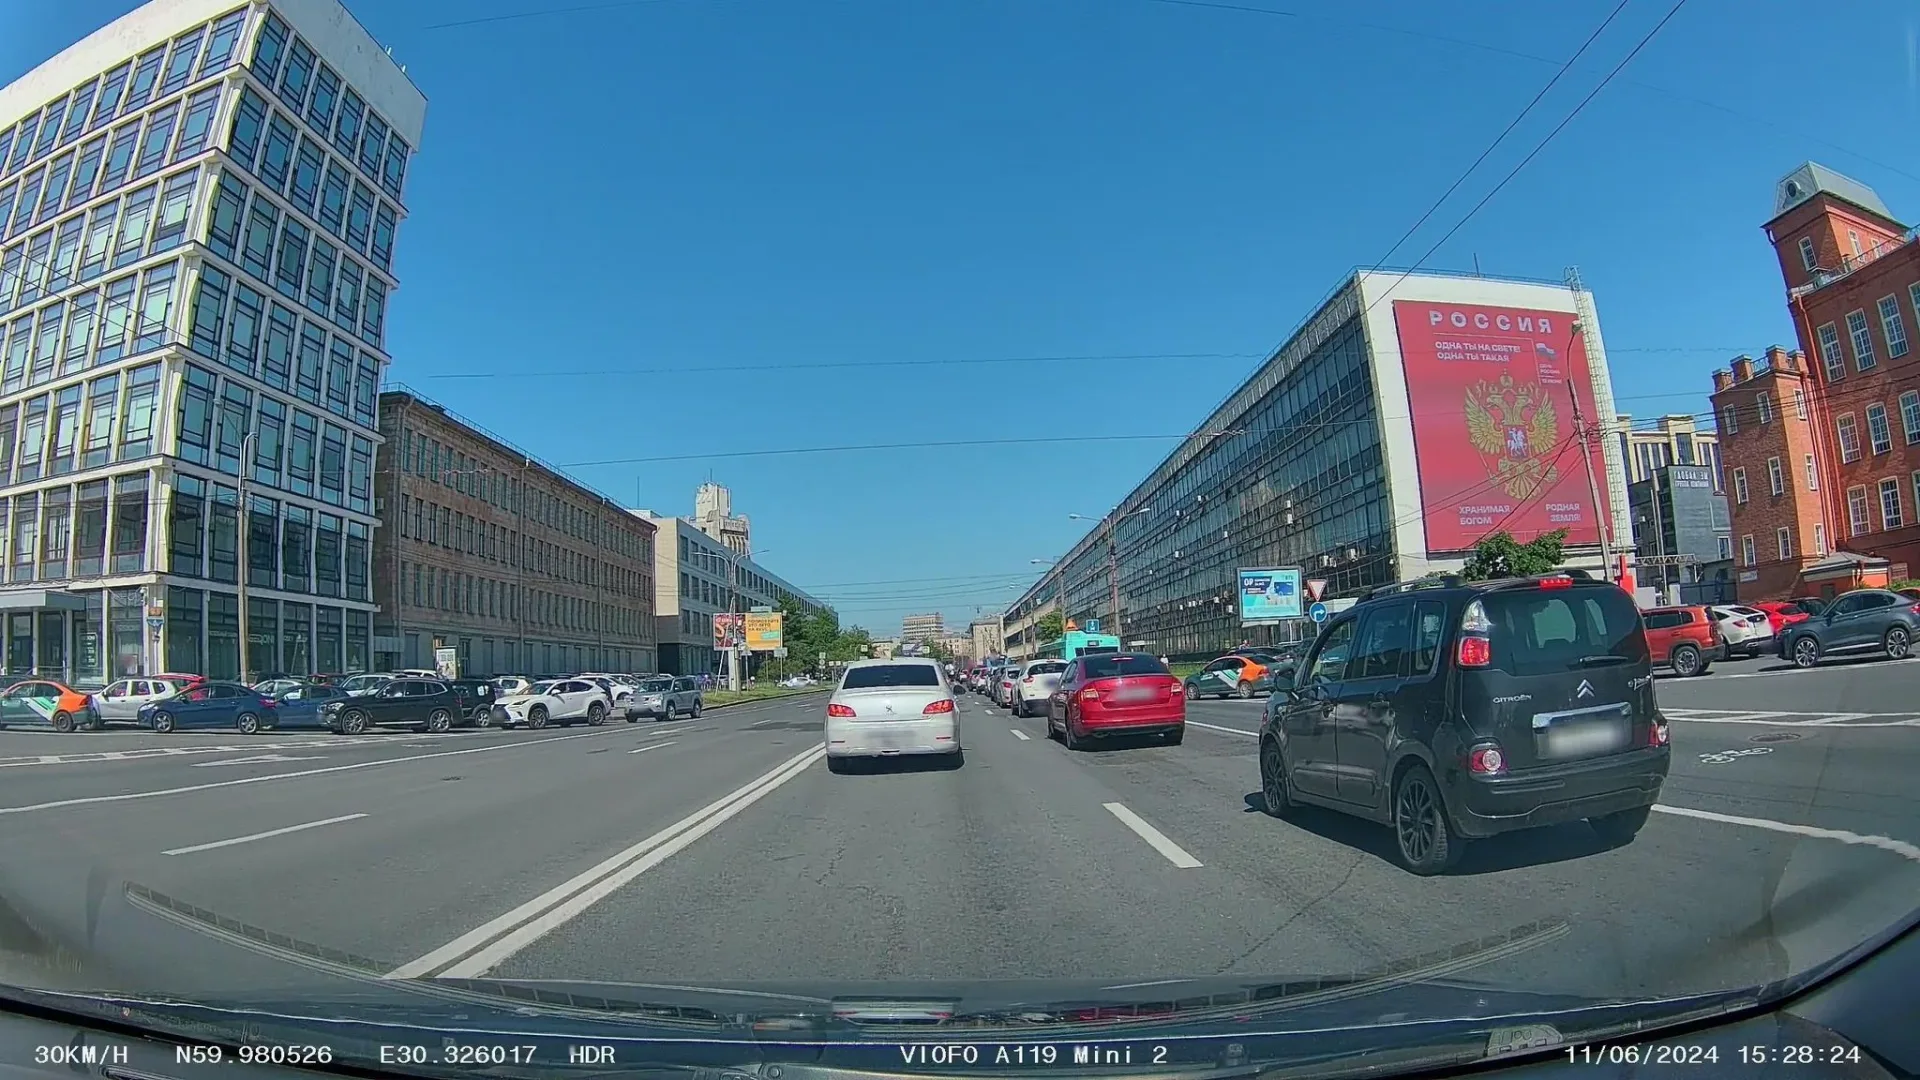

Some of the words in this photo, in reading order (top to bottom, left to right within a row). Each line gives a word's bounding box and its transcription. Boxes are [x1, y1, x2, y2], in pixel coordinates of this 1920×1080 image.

[1428, 310, 1552, 333] РОССИЯ
[1435, 341, 1462, 351] ОДНА
[1463, 343, 1477, 351] ТЫ
[1478, 344, 1491, 352] НА
[1437, 352, 1464, 361] ОДНА
[1465, 353, 1479, 361] ТЫ
[1481, 353, 1510, 362] ТАКАЯ
[1459, 504, 1511, 515] ХРАНИМАЯ
[1545, 503, 1580, 512] РОДНАЯ
[1460, 516, 1492, 525] БОГОМ
